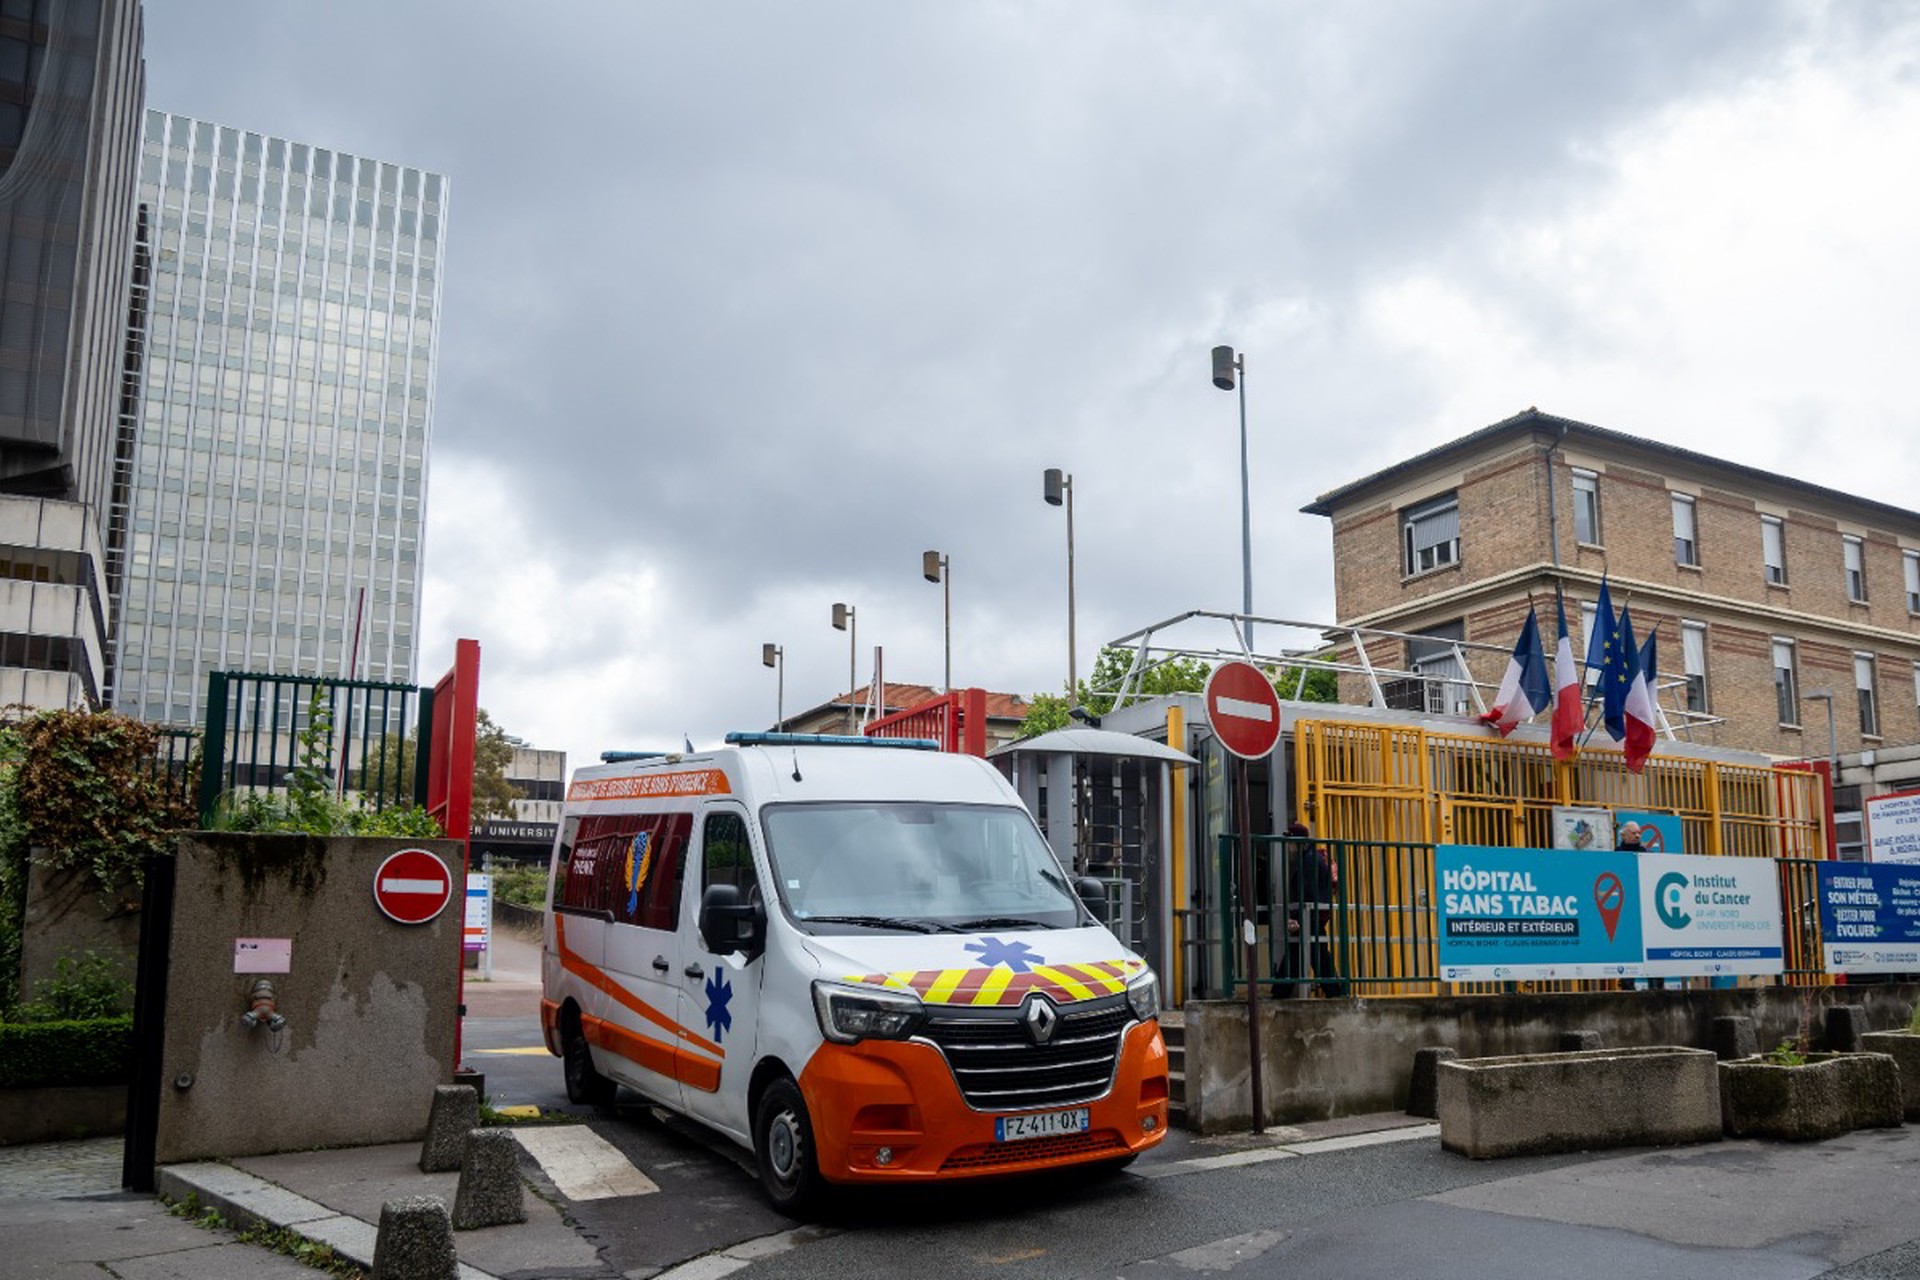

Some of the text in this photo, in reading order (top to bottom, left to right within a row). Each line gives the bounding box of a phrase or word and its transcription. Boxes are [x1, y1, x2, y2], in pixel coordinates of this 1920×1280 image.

[1443, 864, 1537, 892] HÔPITAL
[1693, 874, 1737, 889] Institut
[1445, 893, 1578, 916] SANS TABAC
[1694, 891, 1751, 905] du Cancer
[1451, 920, 1575, 933] INTÉRIEUR ET EXTÉRIEUR
